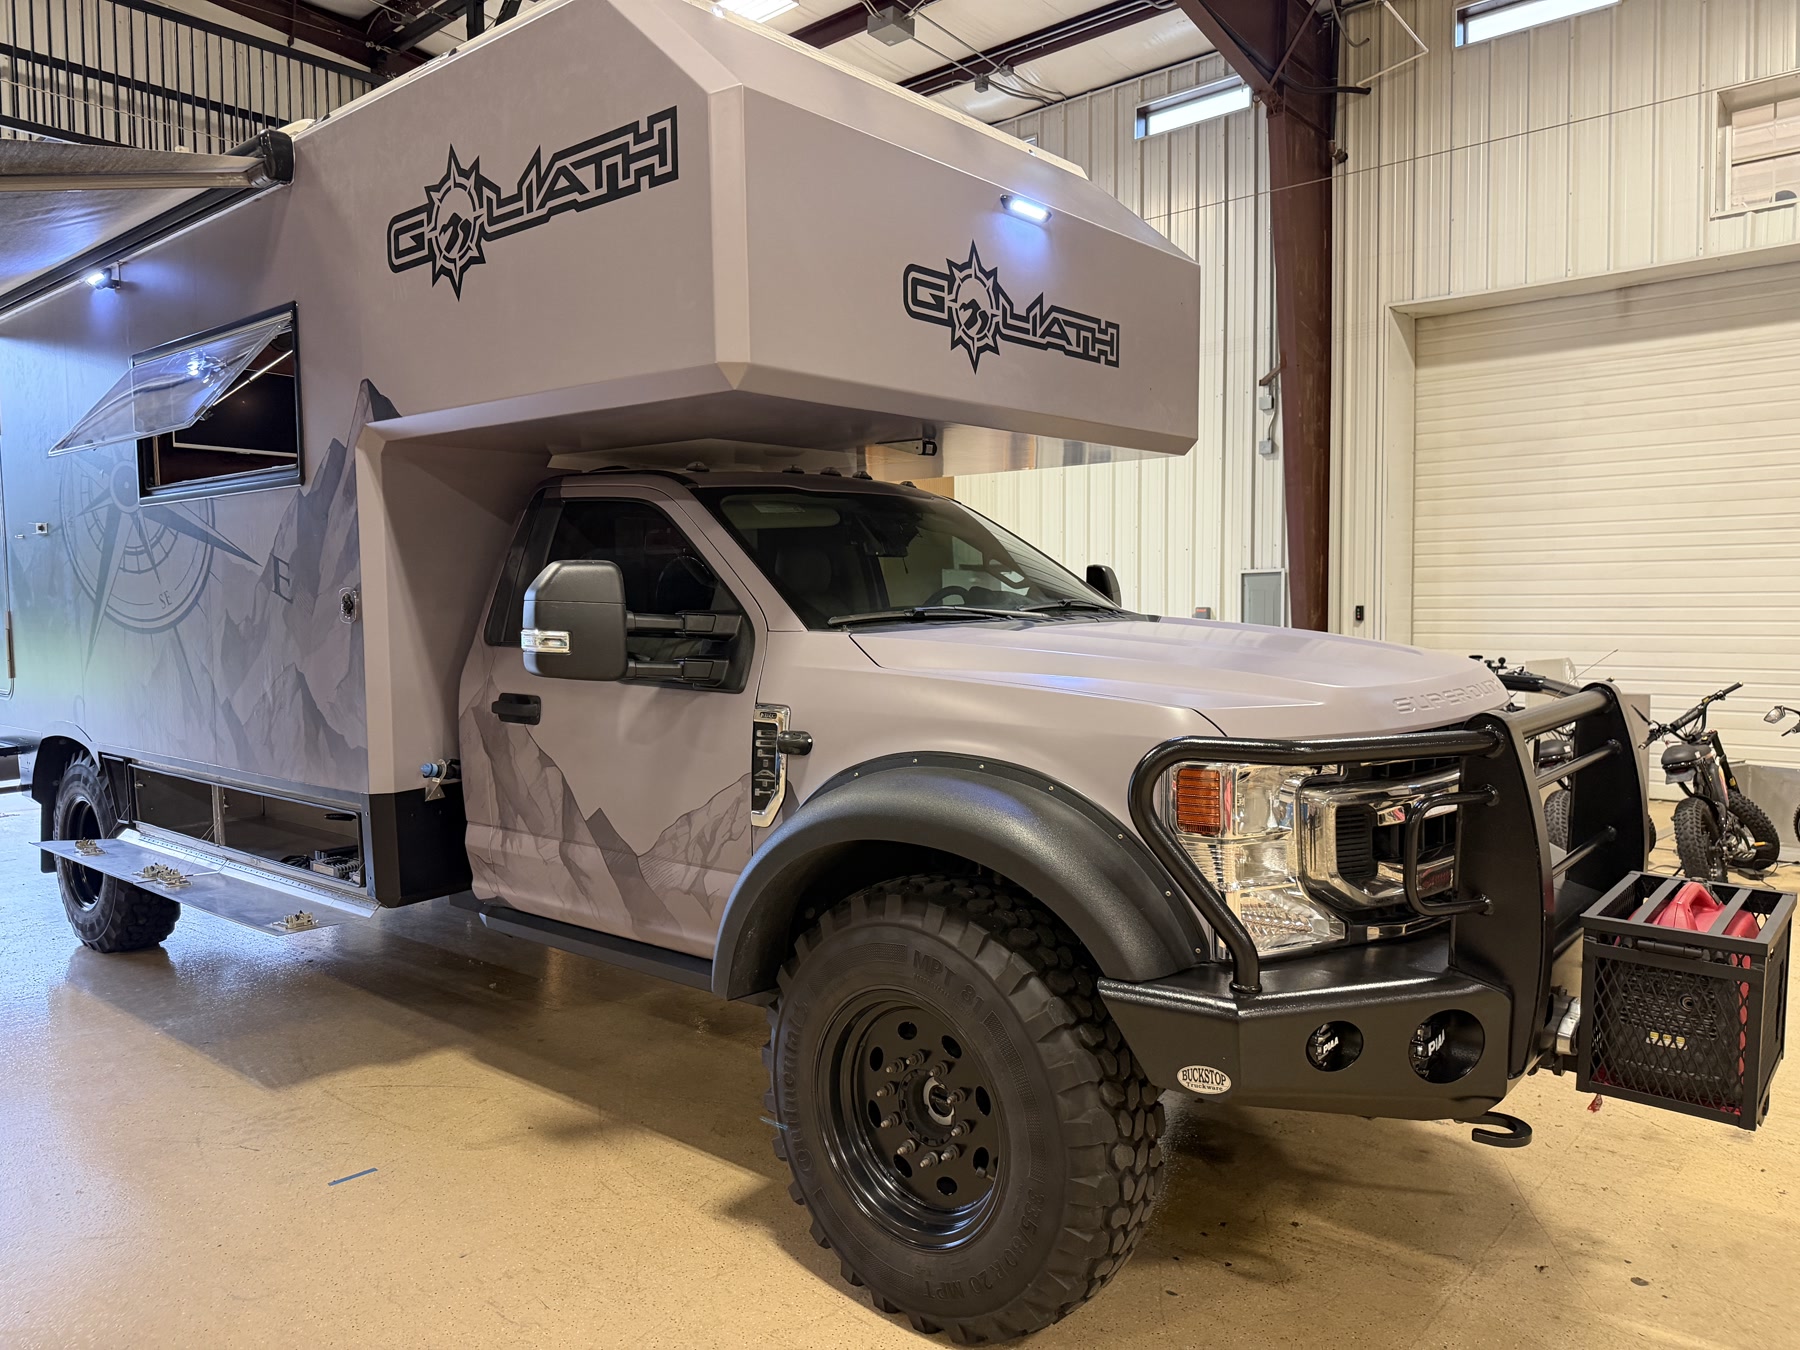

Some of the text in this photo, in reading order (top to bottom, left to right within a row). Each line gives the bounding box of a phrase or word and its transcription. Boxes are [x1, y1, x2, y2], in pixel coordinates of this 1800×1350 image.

[387, 105, 679, 301] GOLIATH
[903, 239, 1120, 374] GOLIATH
[269, 552, 294, 604] E
[1392, 687, 1472, 715] SUPER
[913, 949, 957, 988] MPT
[1181, 1067, 1227, 1086] BUCKSTOP
[1185, 1081, 1224, 1092] Truckware
